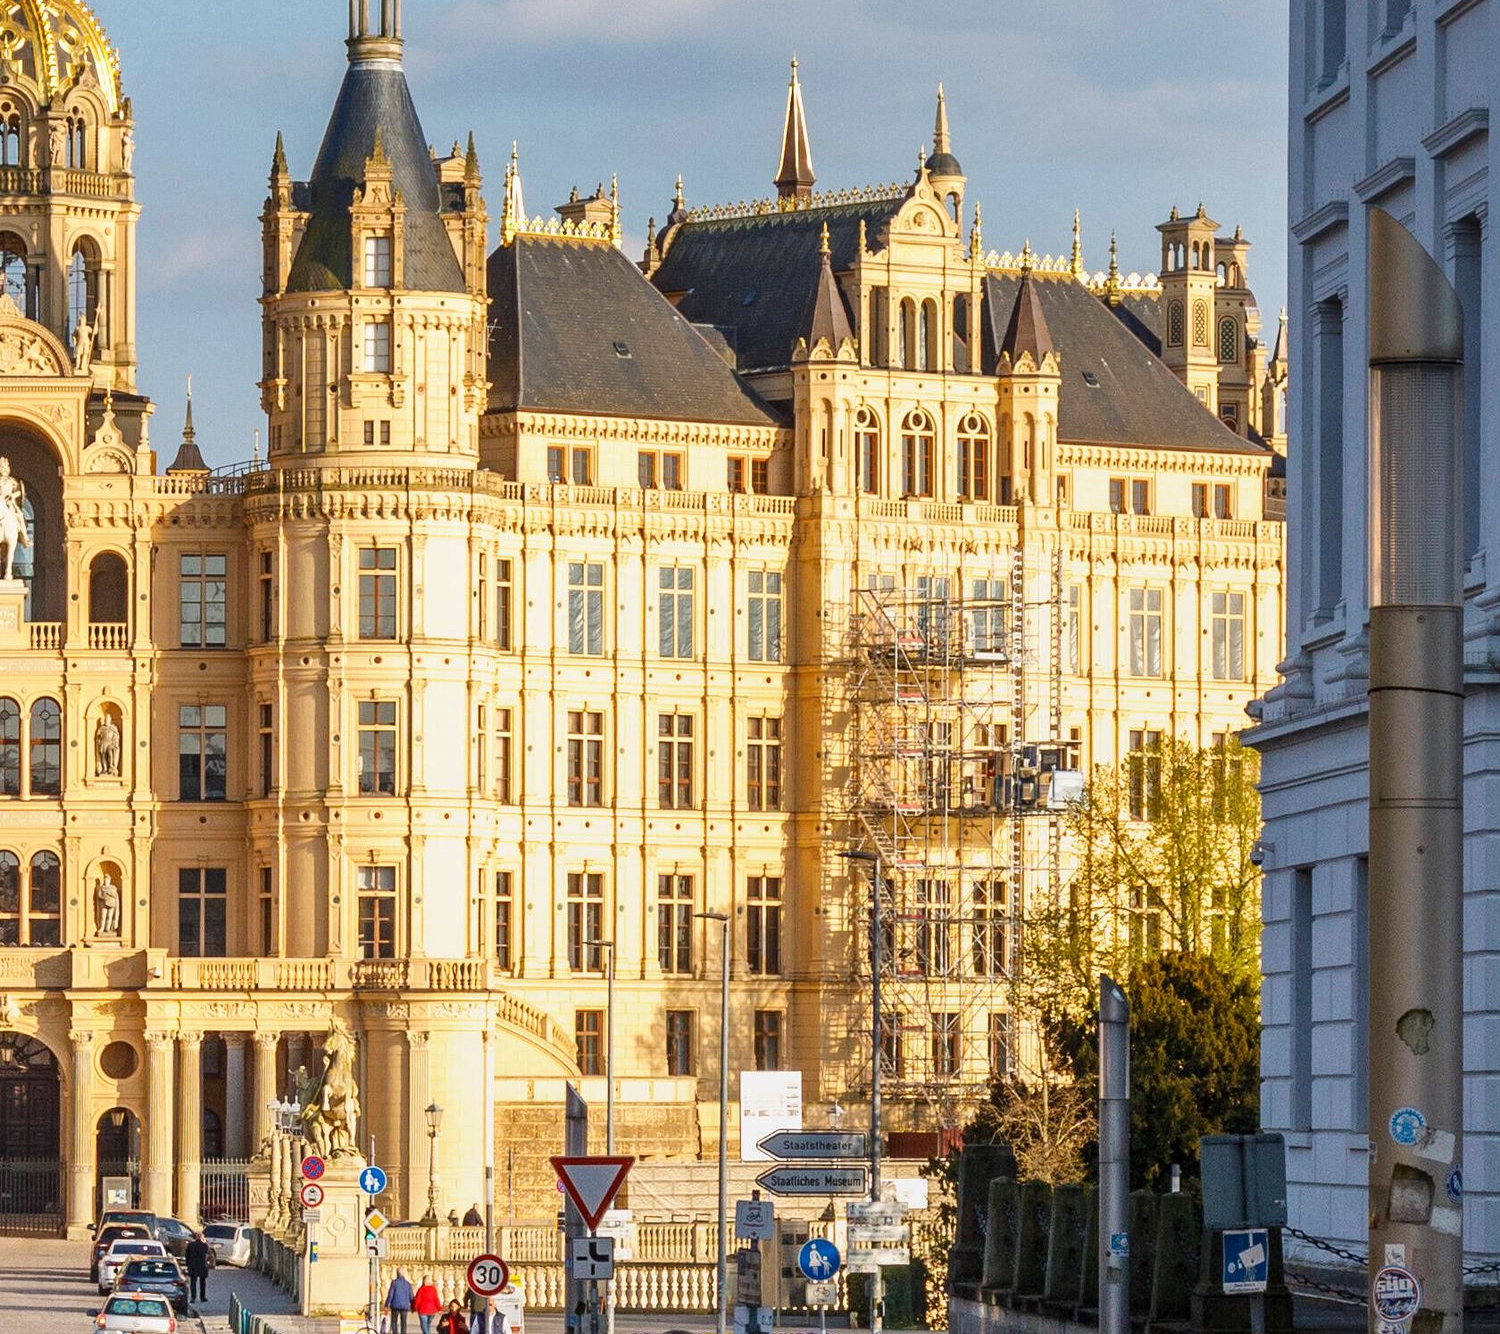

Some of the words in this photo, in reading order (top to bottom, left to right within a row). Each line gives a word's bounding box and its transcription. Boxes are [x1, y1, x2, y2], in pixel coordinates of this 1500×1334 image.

[783, 1140, 853, 1151] Staatstheater
[770, 1175, 820, 1187] Staatliches
[824, 1176, 861, 1187] Museum
[476, 1265, 500, 1285] 30
